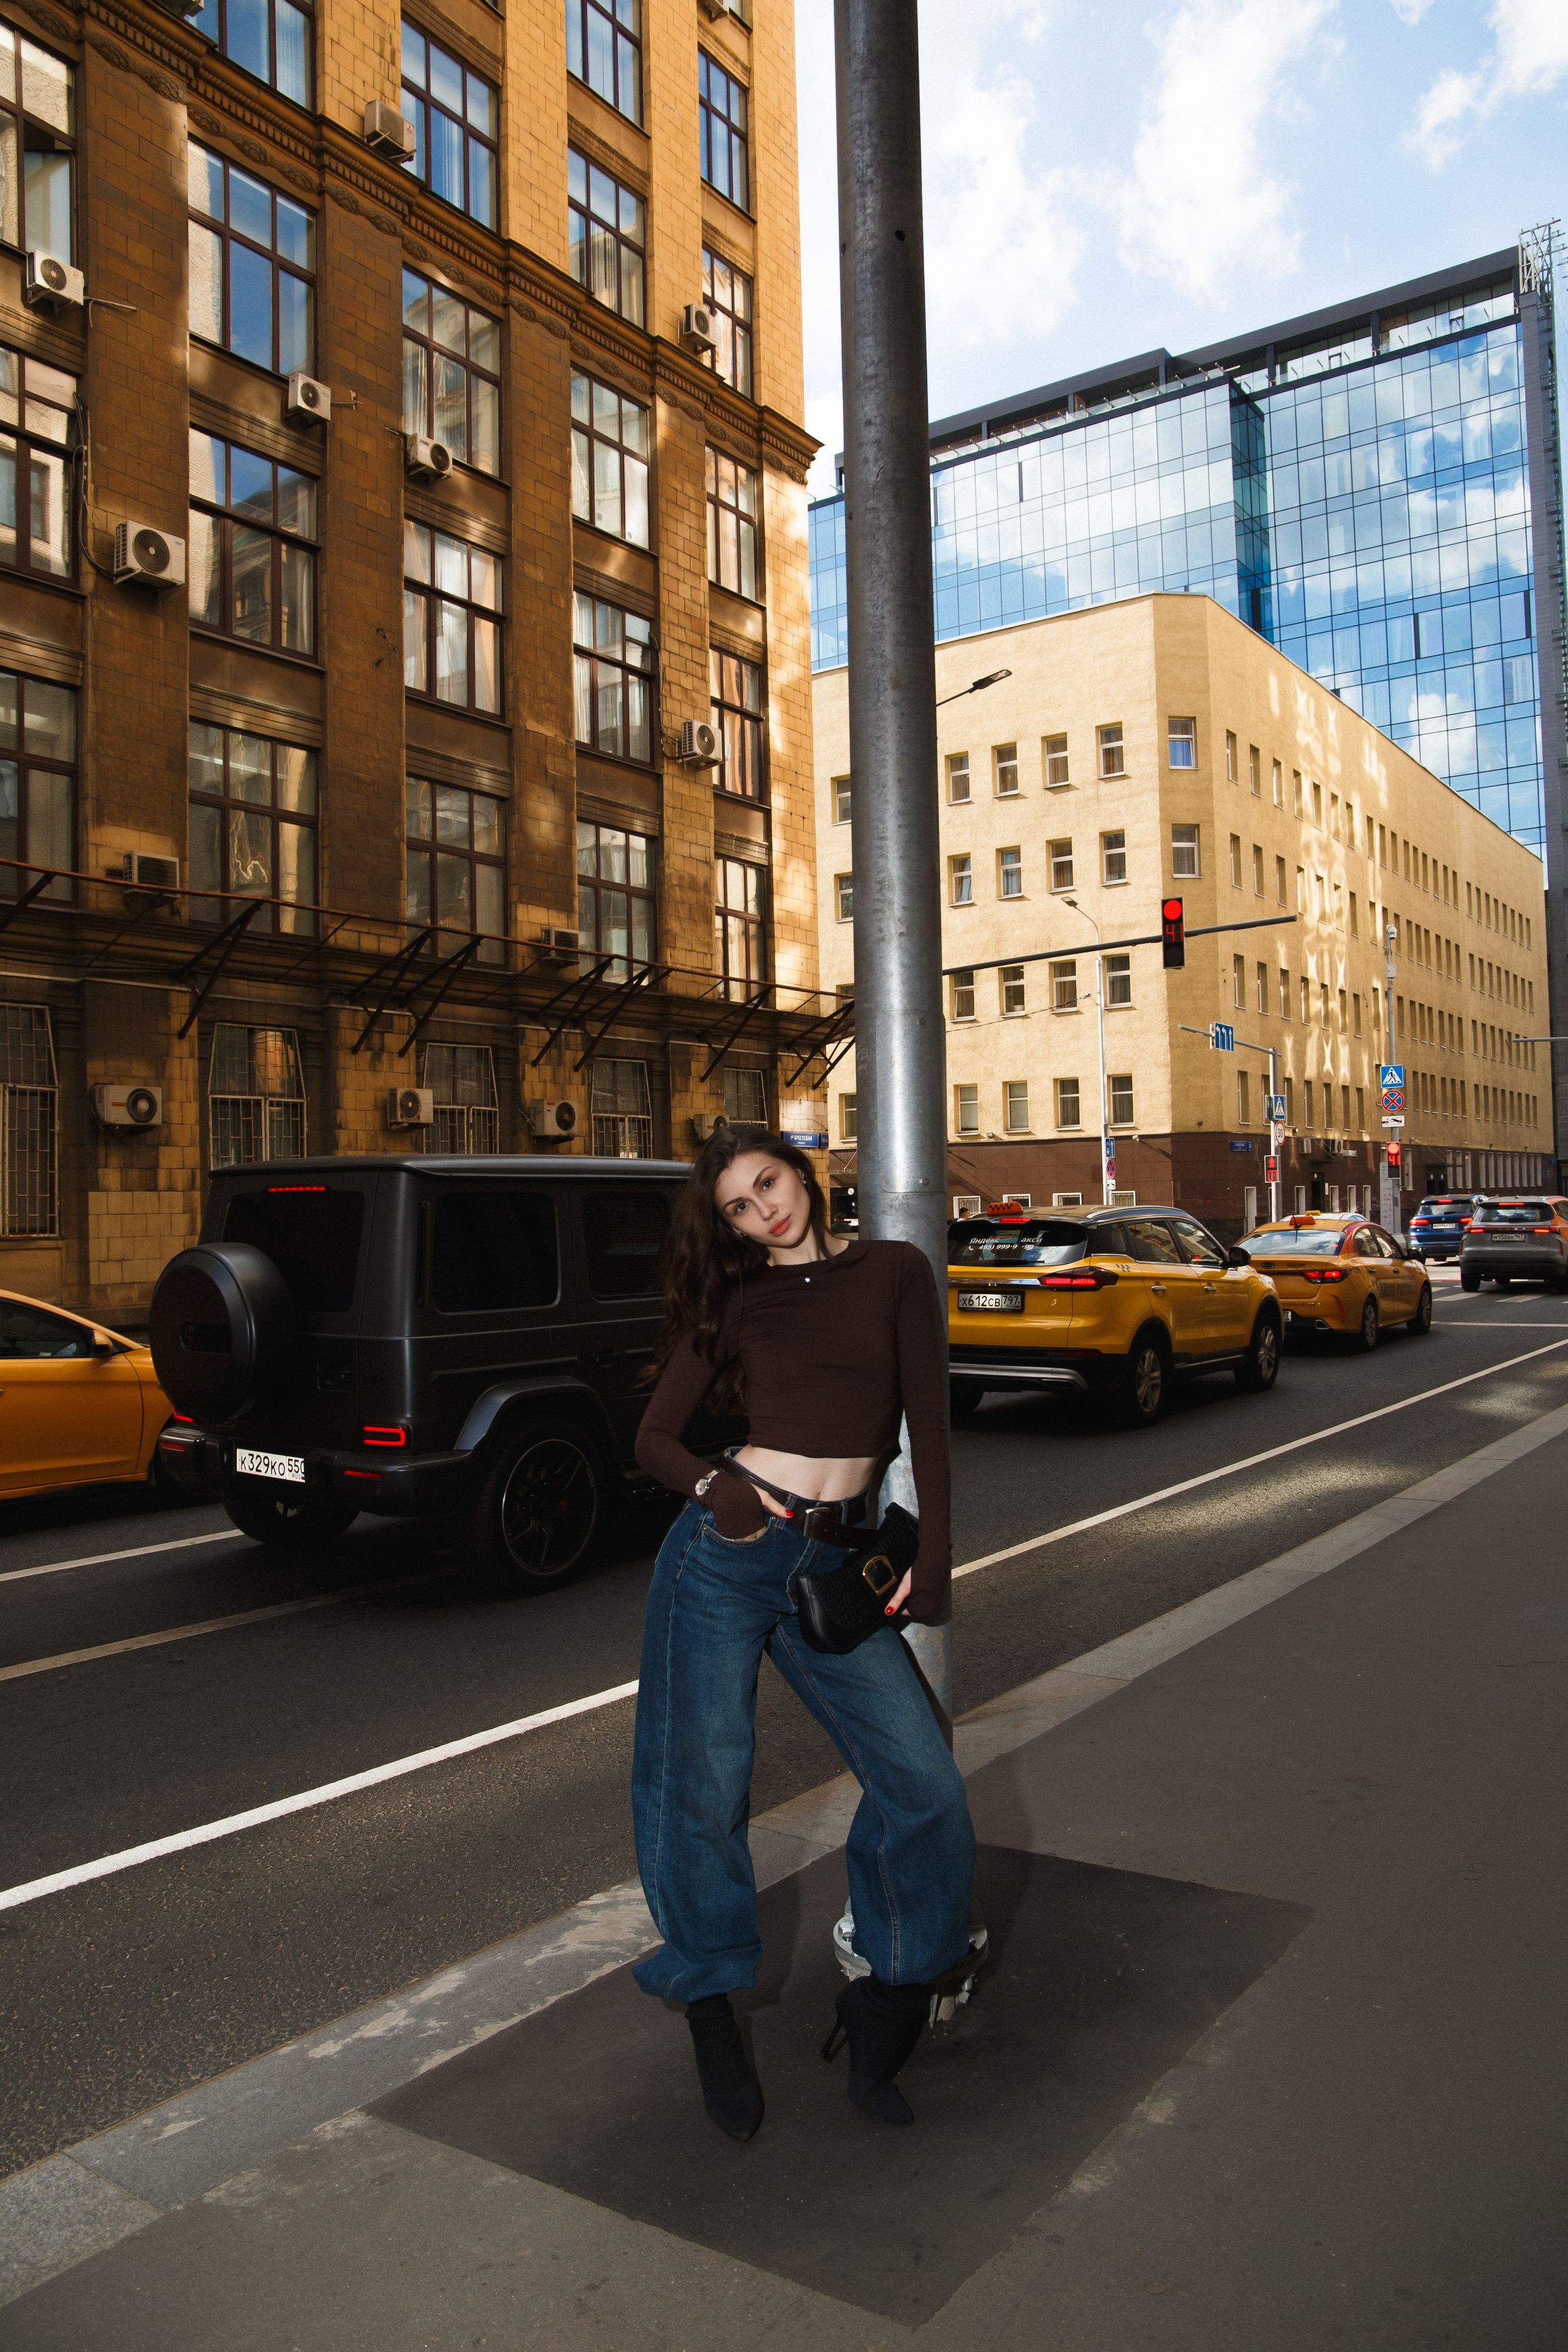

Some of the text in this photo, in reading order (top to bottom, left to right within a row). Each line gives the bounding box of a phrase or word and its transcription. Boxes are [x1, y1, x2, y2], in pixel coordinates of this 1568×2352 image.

[1166, 923, 1183, 942] 41
[1278, 1128, 1283, 1138] 30
[1388, 1155, 1401, 1166] 41
[1003, 1295, 1019, 1305] 797
